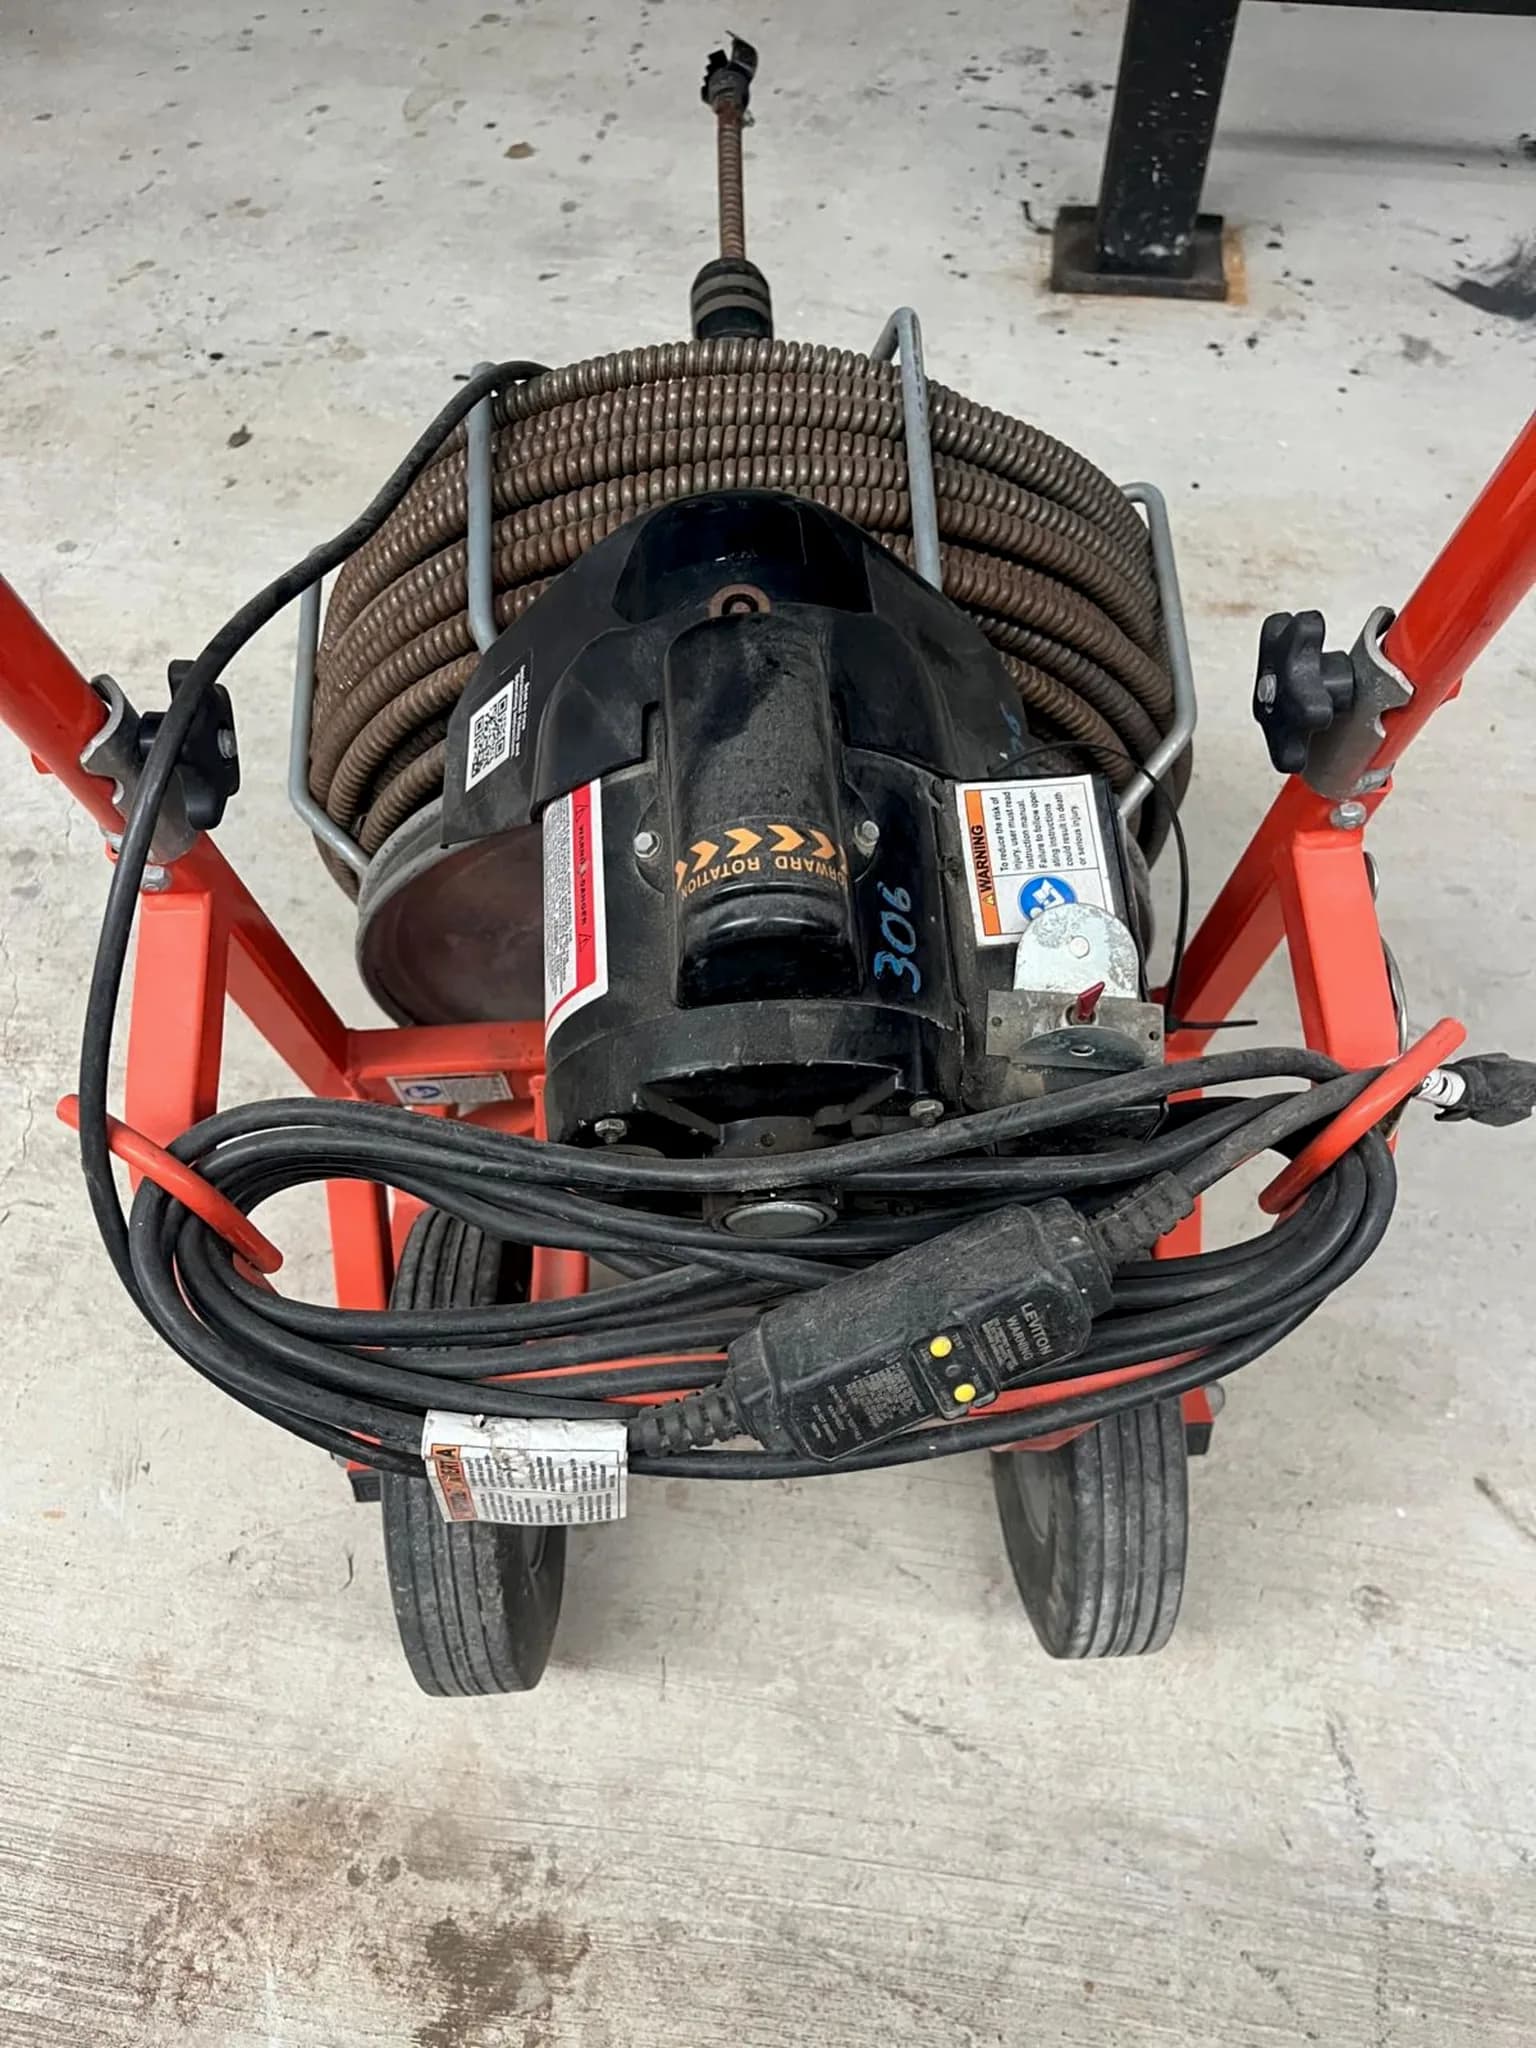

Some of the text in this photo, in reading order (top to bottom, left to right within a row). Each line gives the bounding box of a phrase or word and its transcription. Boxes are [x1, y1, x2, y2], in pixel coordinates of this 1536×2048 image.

[1002, 791, 1012, 808] read
[989, 796, 1009, 872] To reduce the risk of
[1006, 809, 1015, 829] must
[1032, 809, 1042, 833] follow
[1044, 803, 1057, 848] instructions
[1054, 791, 1074, 866] could result in death
[1010, 830, 1018, 846] user
[1022, 830, 1034, 870] instruction
[1035, 833, 1044, 842] to
[1074, 828, 1085, 856] serious
[775, 855, 849, 886] ORWARD
[971, 824, 993, 893] WARNING
[1038, 843, 1048, 869] Failure
[1079, 857, 1087, 866] or
[874, 881, 921, 993] 306
[1006, 1314, 1034, 1361] WARNING
[1021, 1302, 1054, 1356] LEVITON
